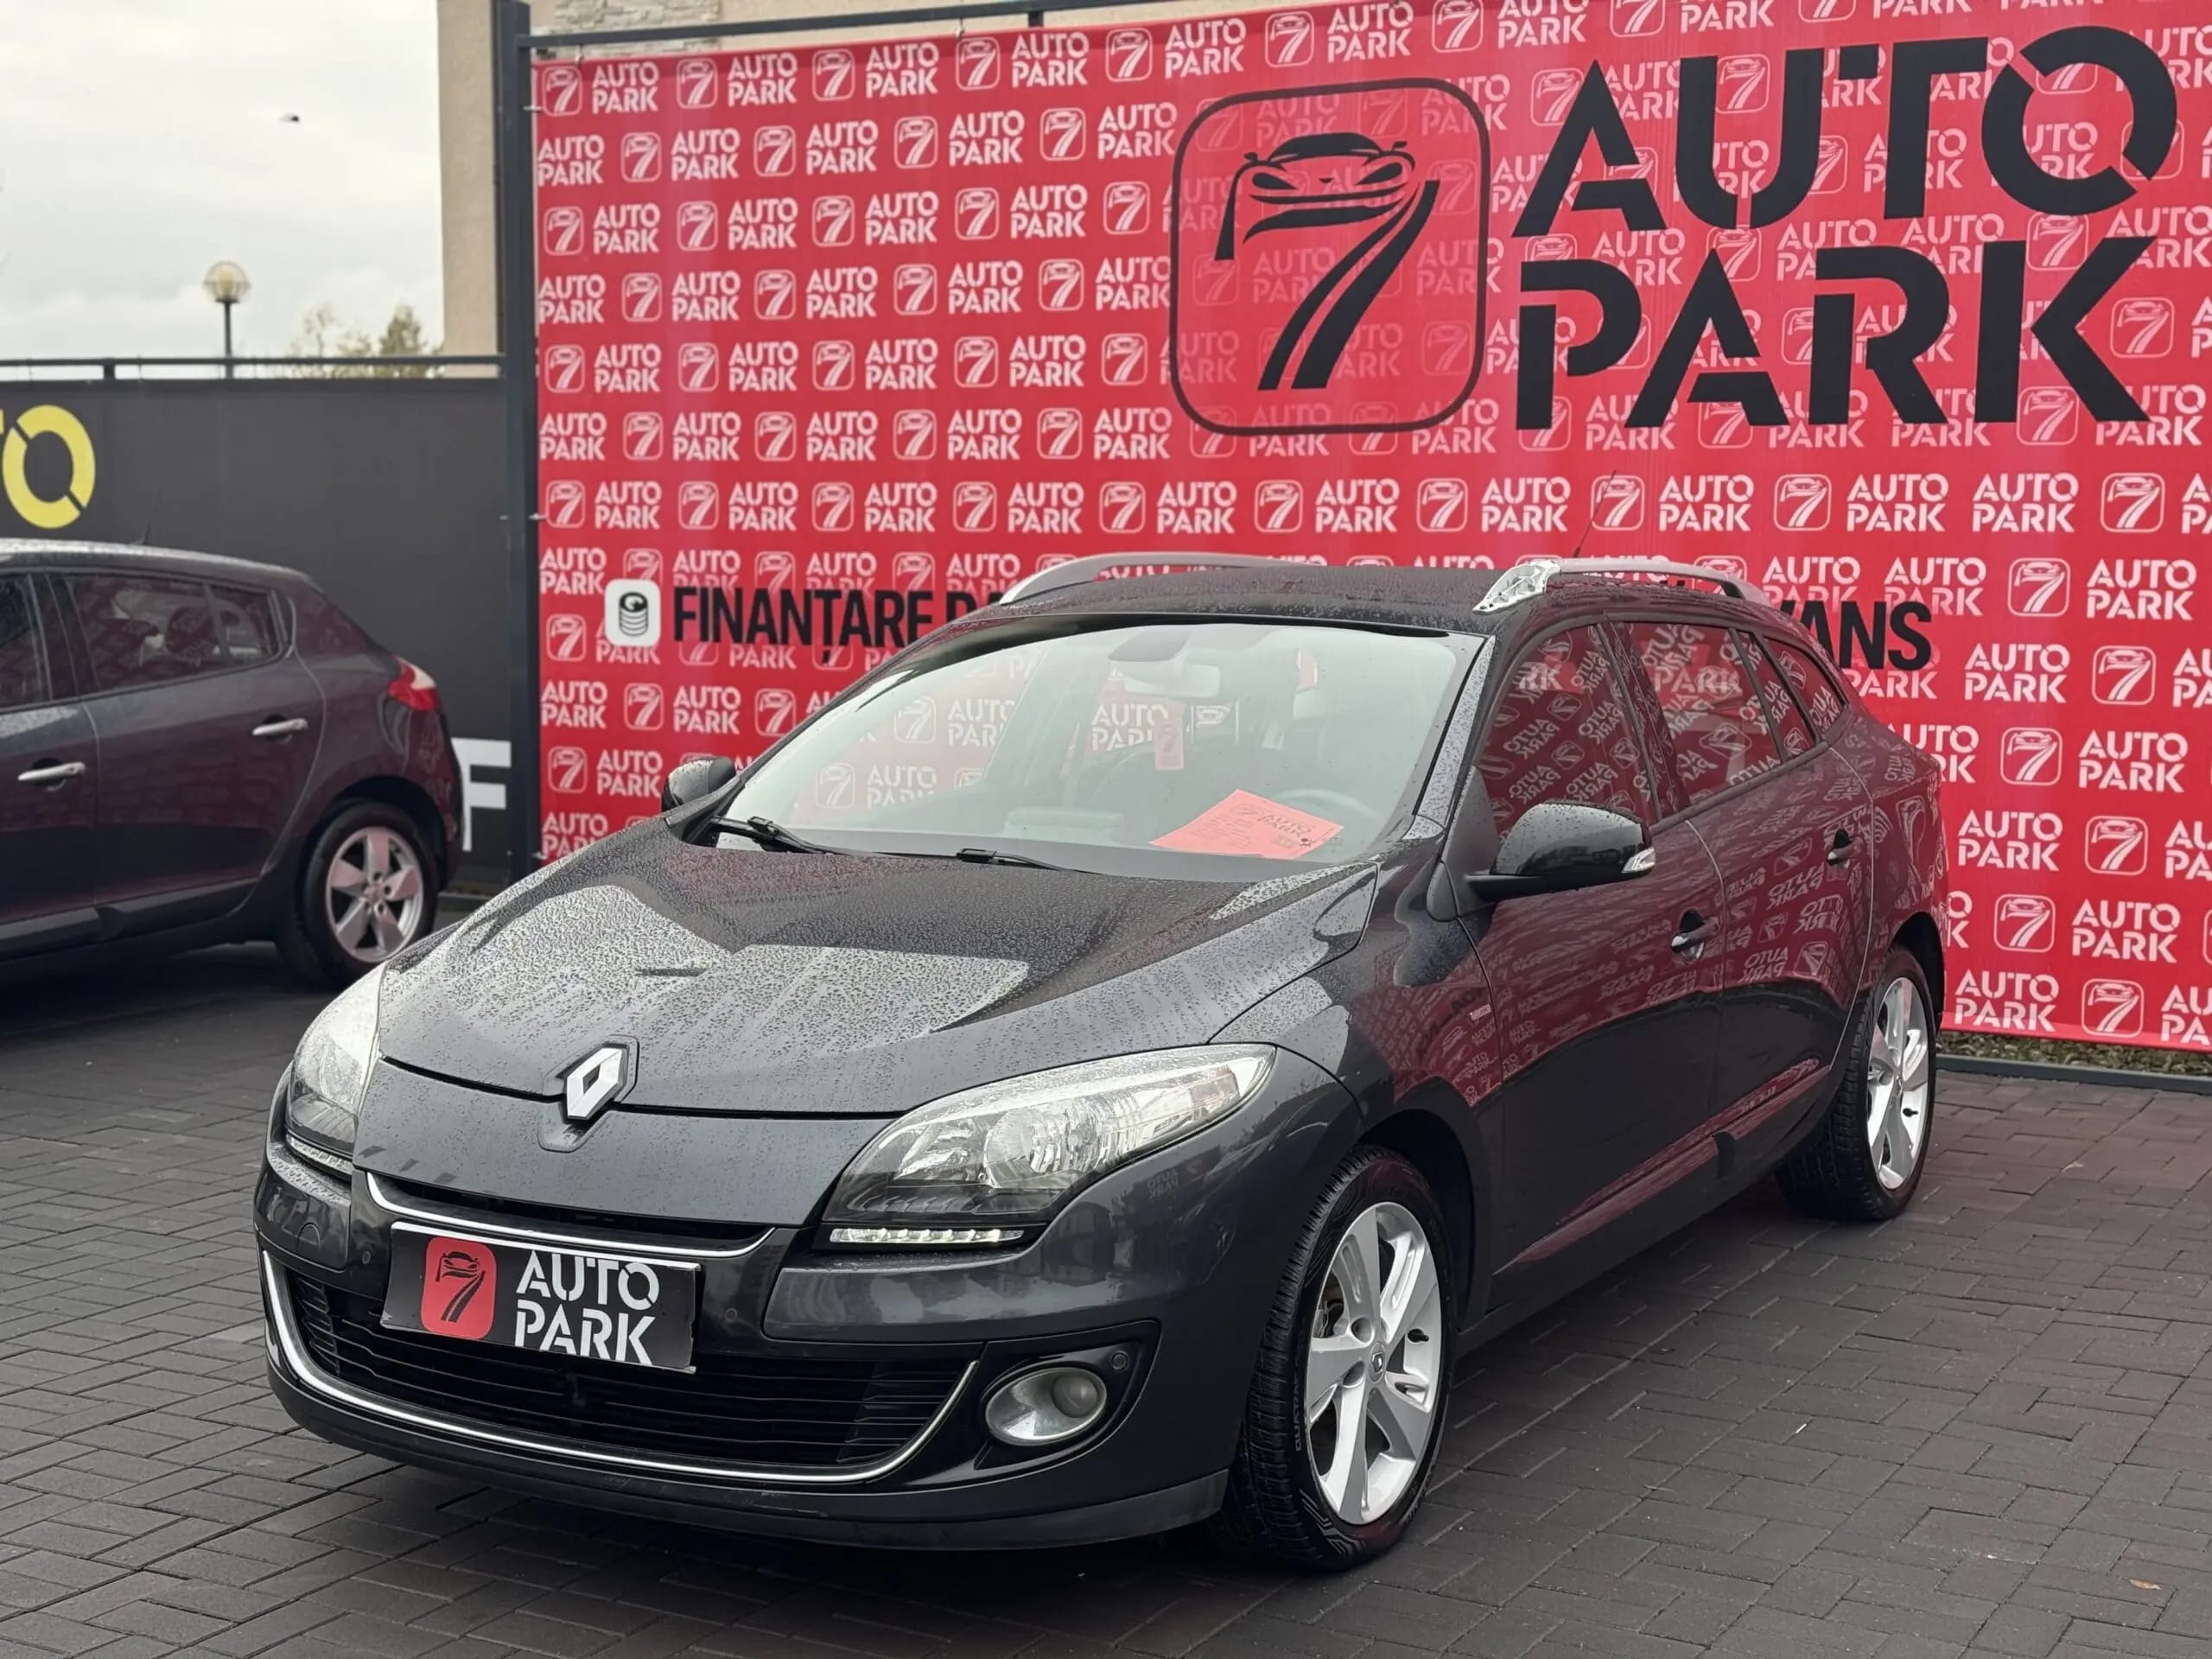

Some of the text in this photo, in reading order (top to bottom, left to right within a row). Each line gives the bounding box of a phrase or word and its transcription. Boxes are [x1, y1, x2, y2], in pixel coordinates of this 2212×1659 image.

[1328, 0, 1413, 34] AUTO
[1497, 0, 1583, 17] AUTO
[1681, 0, 1774, 33] PARK
[1166, 19, 1245, 50] AUTO
[1497, 14, 1586, 48] PARK
[867, 43, 938, 71] AUTO
[1012, 33, 1088, 60] AUTO
[1328, 29, 1410, 62] PARK
[593, 62, 658, 88] AUTO
[728, 54, 797, 80] AUTO
[1013, 59, 1087, 87] PARK
[1166, 46, 1243, 79] PARK
[728, 78, 796, 106] PARK
[867, 68, 937, 98] PARK
[593, 86, 658, 113] PARK
[950, 111, 1024, 139] AUTO
[1098, 103, 1177, 131] AUTO
[671, 129, 740, 155] AUTO
[807, 120, 878, 149] AUTO
[1511, 24, 2177, 238] AUTO
[538, 136, 604, 162] AUTO
[950, 137, 1021, 166] PARK
[1098, 130, 1173, 159] PARK
[672, 154, 737, 181] PARK
[807, 146, 875, 175] PARK
[538, 161, 602, 187] PARK
[866, 191, 938, 219] AUTO
[1011, 184, 1087, 211] AUTO
[594, 203, 660, 229] AUTO
[728, 198, 798, 225] AUTO
[1011, 211, 1084, 238] PARK
[2106, 206, 2212, 238] AUTO
[594, 228, 658, 253] PARK
[729, 223, 796, 249] PARK
[866, 217, 936, 245] PARK
[1777, 219, 1877, 252] AUTO
[1901, 213, 2004, 245] AUTO
[1592, 227, 1685, 258] AUTO
[806, 267, 878, 293] AUTO
[949, 261, 1023, 287] AUTO
[1096, 257, 1170, 283] AUTO
[539, 275, 605, 300] AUTO
[672, 271, 741, 297] AUTO
[1096, 283, 1169, 309] PARK
[539, 300, 603, 323] PARK
[673, 296, 738, 321] PARK
[807, 292, 875, 318] PARK
[949, 287, 1020, 314] PARK
[1516, 234, 2159, 430] PARK
[594, 344, 661, 368] AUTO
[729, 341, 798, 366] AUTO
[866, 339, 938, 364] AUTO
[1010, 335, 1085, 360] AUTO
[595, 368, 659, 391] PARK
[730, 366, 796, 391] PARK
[866, 365, 936, 389] PARK
[1010, 361, 1083, 386] PARK
[540, 413, 607, 435] AUTO
[673, 412, 741, 435] AUTO
[807, 411, 878, 435] AUTO
[948, 409, 1021, 434] AUTO
[1094, 408, 1172, 433] AUTO
[1891, 419, 1991, 448] PARK
[2096, 416, 2202, 447] PARK
[948, 435, 1019, 459] PARK
[1095, 434, 1169, 459] PARK
[1249, 430, 1330, 457] PARK
[1411, 426, 1496, 454] PARK
[1586, 421, 1675, 451] PARK
[1769, 420, 1864, 448] PARK
[540, 435, 604, 460] PARK
[674, 436, 739, 460] PARK
[807, 435, 875, 461] PARK
[595, 481, 661, 505] AUTO
[729, 482, 798, 505] AUTO
[865, 482, 937, 506] AUTO
[1008, 482, 1084, 507] AUTO
[1158, 481, 1236, 506] AUTO
[1316, 479, 1399, 505] AUTO
[1482, 477, 1570, 504] AUTO
[1660, 475, 1753, 502] AUTO
[1847, 474, 1948, 501] AUTO
[1974, 474, 2078, 501] AUTO
[595, 505, 659, 529] PARK
[729, 505, 796, 531] PARK
[866, 507, 934, 531] PARK
[1008, 507, 1081, 533] PARK
[1158, 508, 1234, 533] PARK
[1316, 506, 1396, 532] PARK
[1482, 505, 1567, 531] PARK
[1660, 504, 1750, 531] PARK
[1847, 504, 1945, 531] PARK
[1973, 504, 2075, 531] PARK
[540, 548, 606, 571] AUTO
[672, 550, 741, 575] AUTO
[806, 552, 877, 577] AUTO
[947, 553, 1020, 578] AUTO
[1762, 556, 1861, 585] AUTO
[1884, 556, 1987, 587] AUTO
[540, 571, 605, 595] PARK
[2088, 560, 2196, 589] AUTO
[2088, 589, 2192, 620] PARK
[595, 641, 661, 664] PARK
[729, 645, 797, 670] PARK
[1966, 644, 2069, 672] AUTO
[541, 681, 607, 704] AUTO
[674, 686, 741, 709] AUTO
[1966, 673, 2066, 702] PARK
[542, 702, 606, 728] PARK
[674, 709, 739, 734] PARK
[2080, 731, 2187, 762] AUTO
[597, 750, 663, 773] AUTO
[598, 772, 661, 798] PARK
[868, 765, 937, 788] AUTO
[2080, 760, 2183, 792] PARK
[543, 812, 607, 836] AUTO
[1959, 810, 2063, 841] AUTO
[1959, 839, 2058, 871] PARK
[2073, 899, 2180, 932] AUTO
[2073, 928, 2176, 963] PARK
[1955, 970, 2058, 1001] AUTO
[1955, 998, 2056, 1032] PARK
[517, 1249, 659, 1311] AUTO
[514, 1299, 657, 1365] PARK
